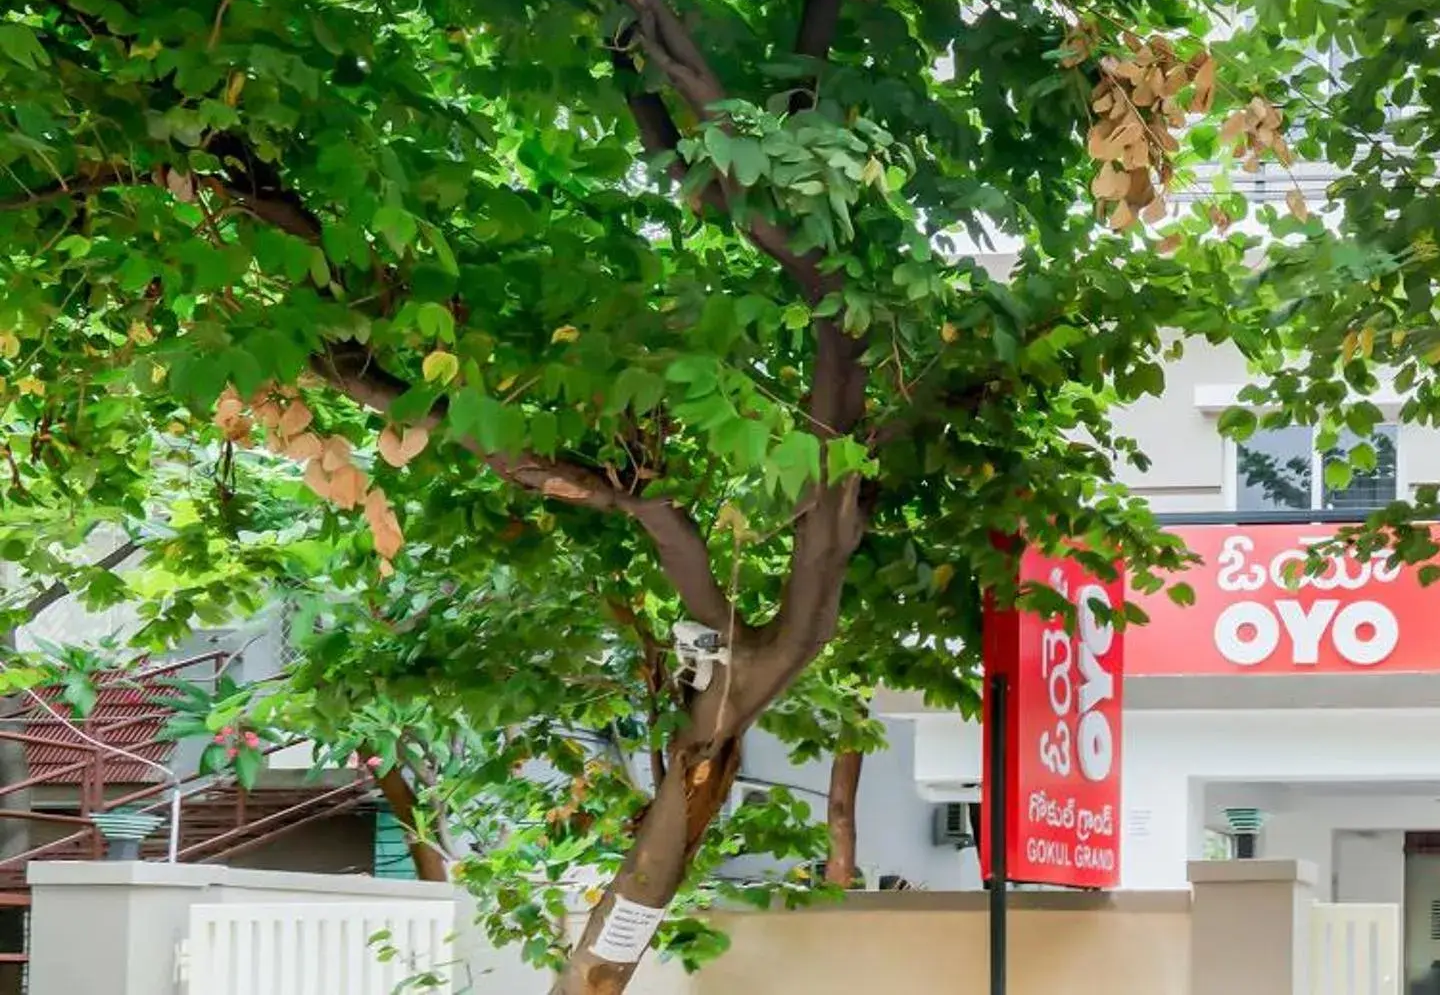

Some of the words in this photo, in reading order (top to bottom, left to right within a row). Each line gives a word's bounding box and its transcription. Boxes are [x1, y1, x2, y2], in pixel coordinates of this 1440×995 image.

[1217, 535, 1402, 591] ఓయో
[1214, 600, 1399, 665] OYO
[1077, 585, 1114, 781] OYO
[1026, 837, 1072, 866] GOKUL
[1074, 844, 1114, 871] GRAND
